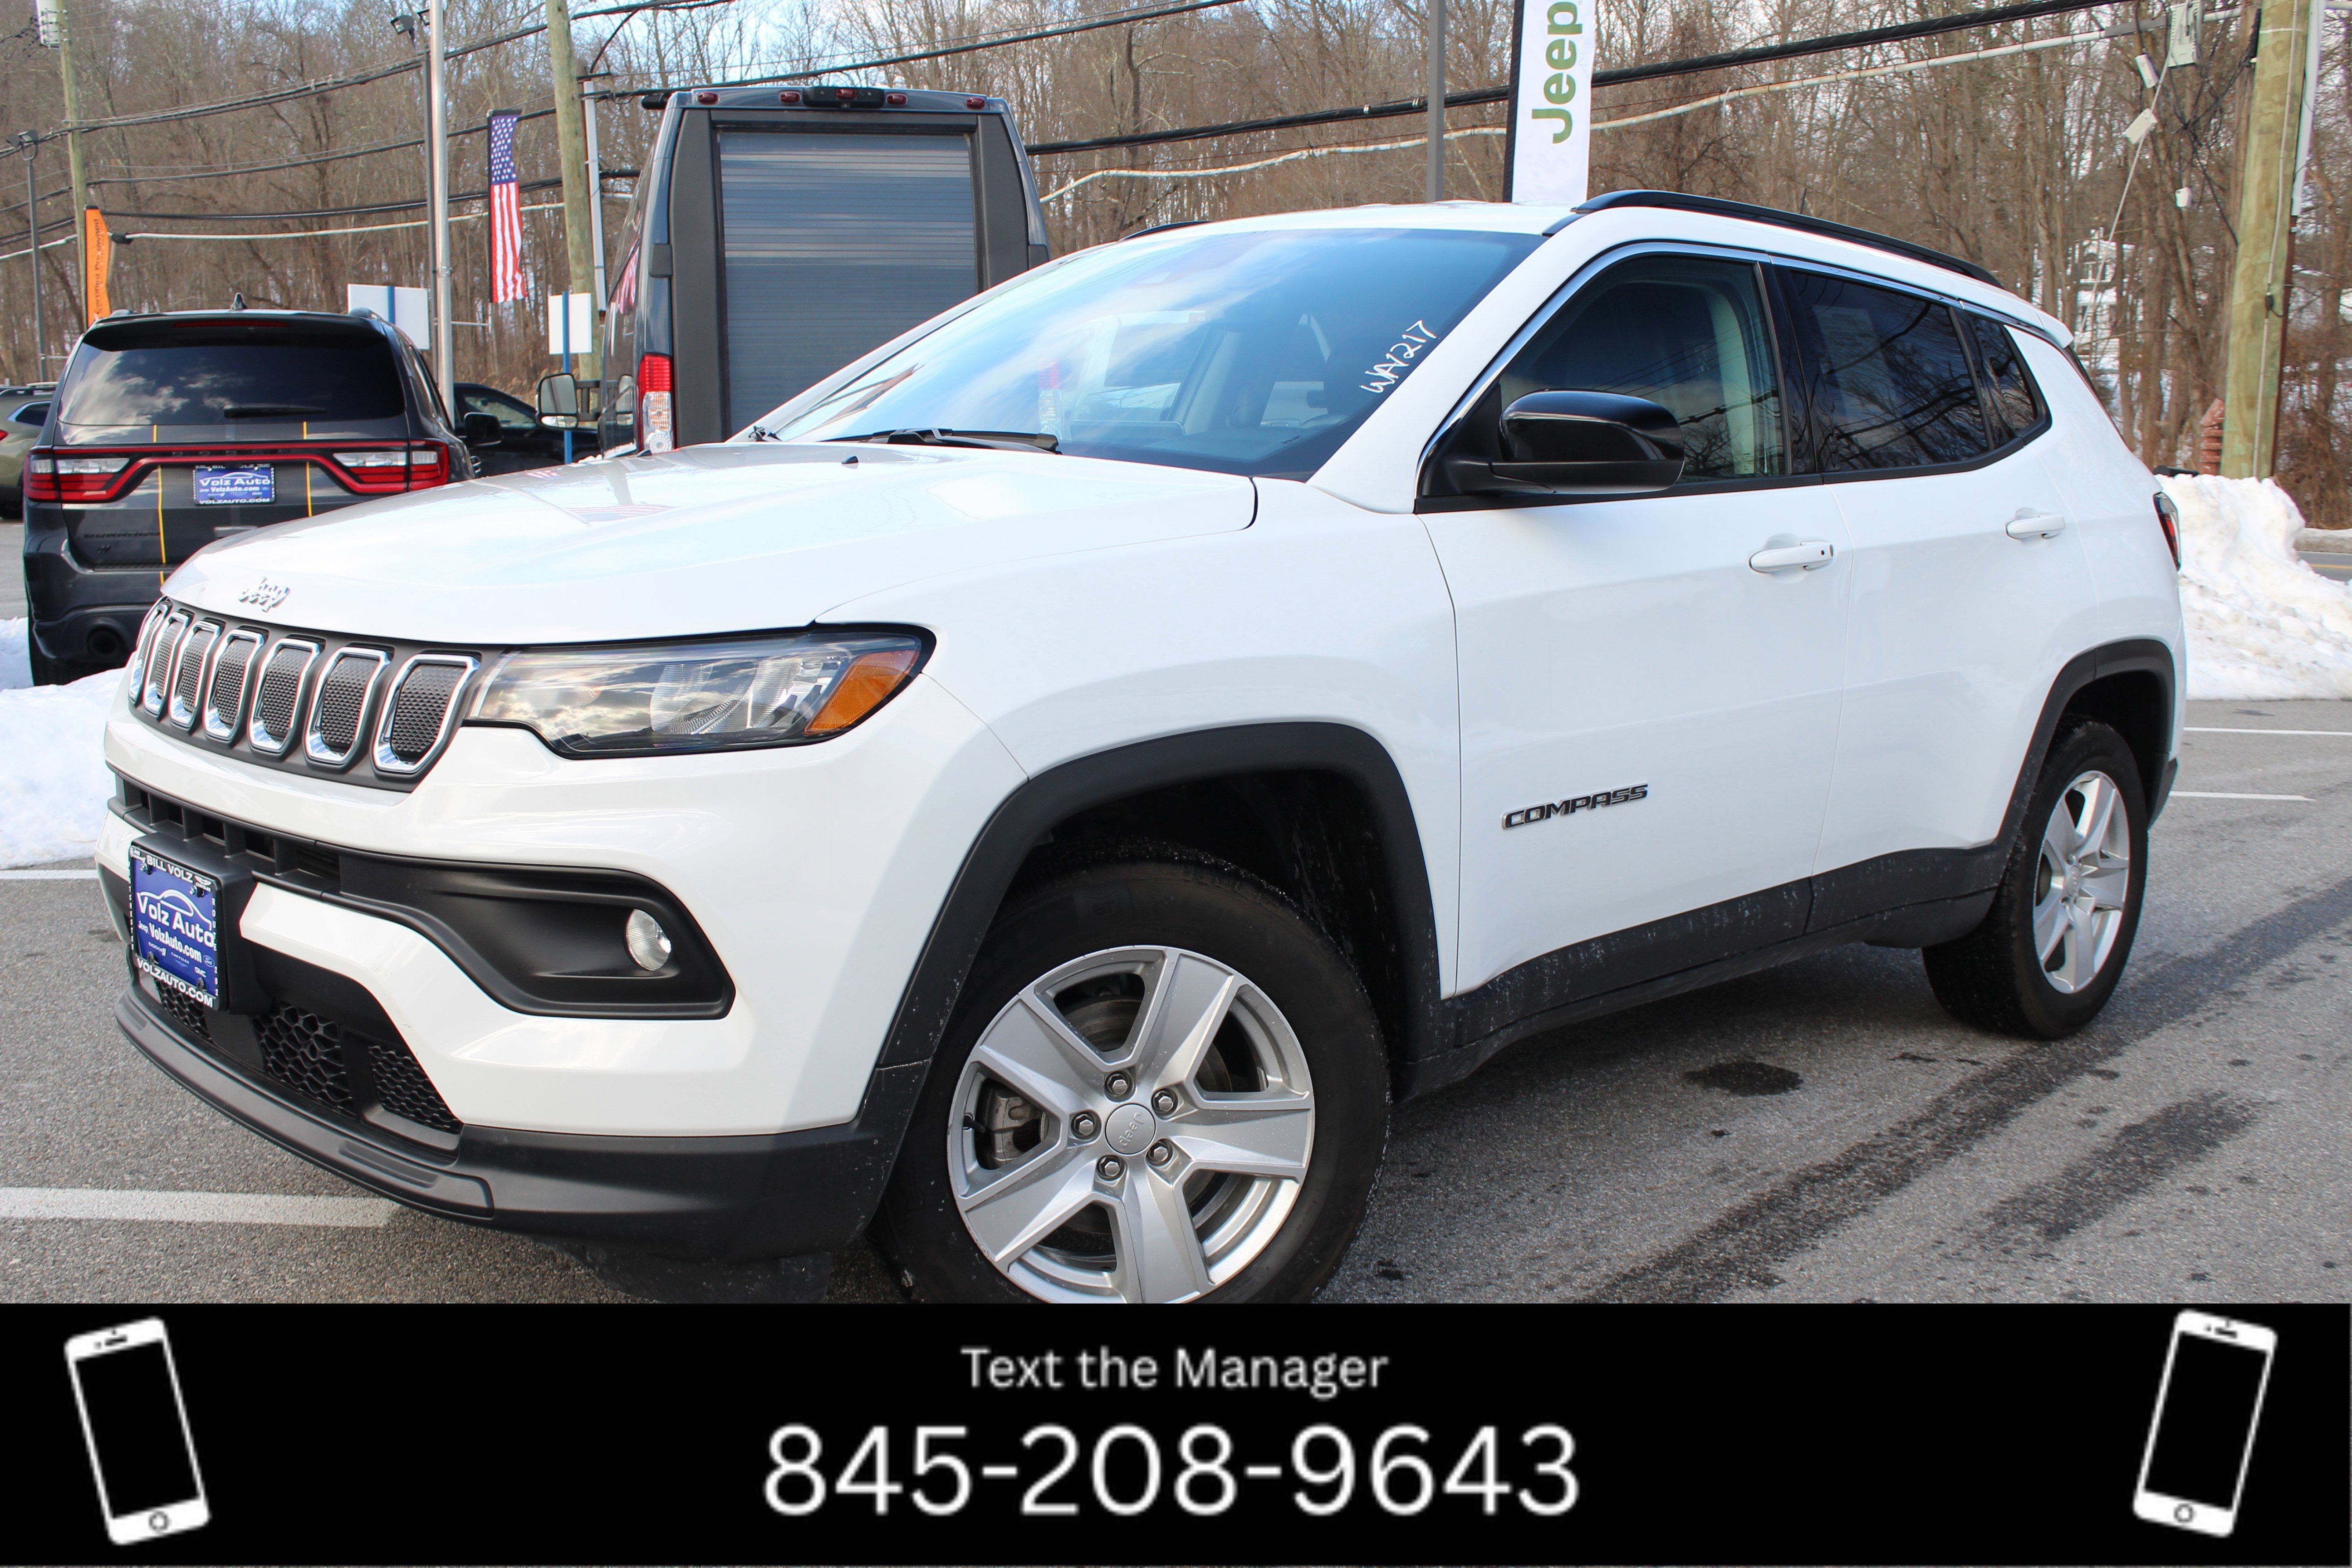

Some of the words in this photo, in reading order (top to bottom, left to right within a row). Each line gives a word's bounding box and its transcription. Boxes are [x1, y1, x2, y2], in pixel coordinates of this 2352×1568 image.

[1532, 1, 1583, 144] Jeep
[199, 478, 231, 486] Volz
[238, 577, 291, 612] Jeep
[1502, 782, 1649, 830] COMPASS
[146, 854, 167, 872] BILL
[167, 863, 193, 884] VOLZ
[137, 892, 170, 926] Volz
[172, 911, 214, 948] Auto
[149, 922, 202, 963] VolzAuto.com
[137, 958, 213, 1008] VOLZAUTO.COM
[195, 966, 206, 978] GMC
[1119, 1111, 1145, 1147] Jeep
